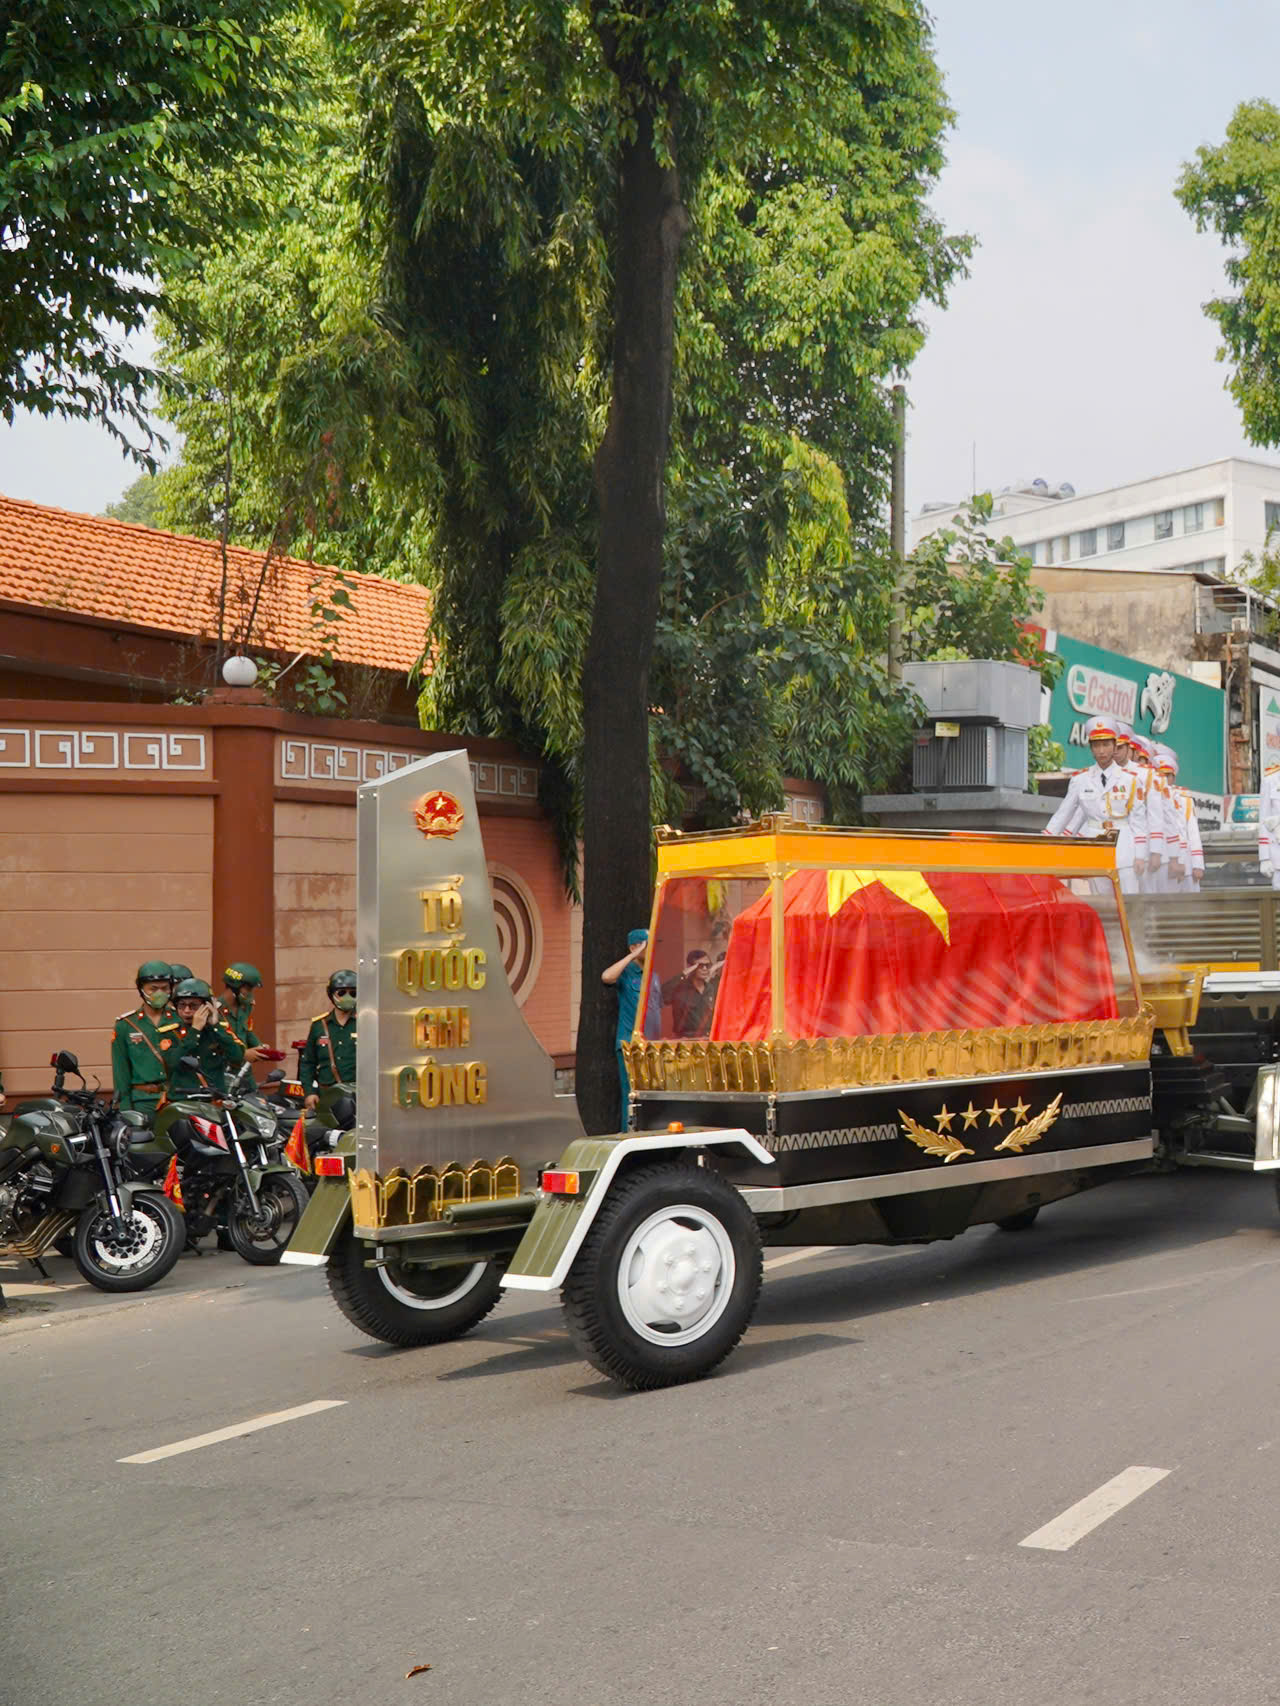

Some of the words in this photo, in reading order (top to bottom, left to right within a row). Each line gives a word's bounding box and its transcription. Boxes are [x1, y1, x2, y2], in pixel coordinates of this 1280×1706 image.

[1087, 674, 1135, 720] Castrol
[1069, 721, 1089, 747] AU
[419, 873, 464, 933] TỔ
[396, 932, 487, 996] QUỐC
[414, 1005, 471, 1049] GHI
[394, 1055, 489, 1109] CÔNG
